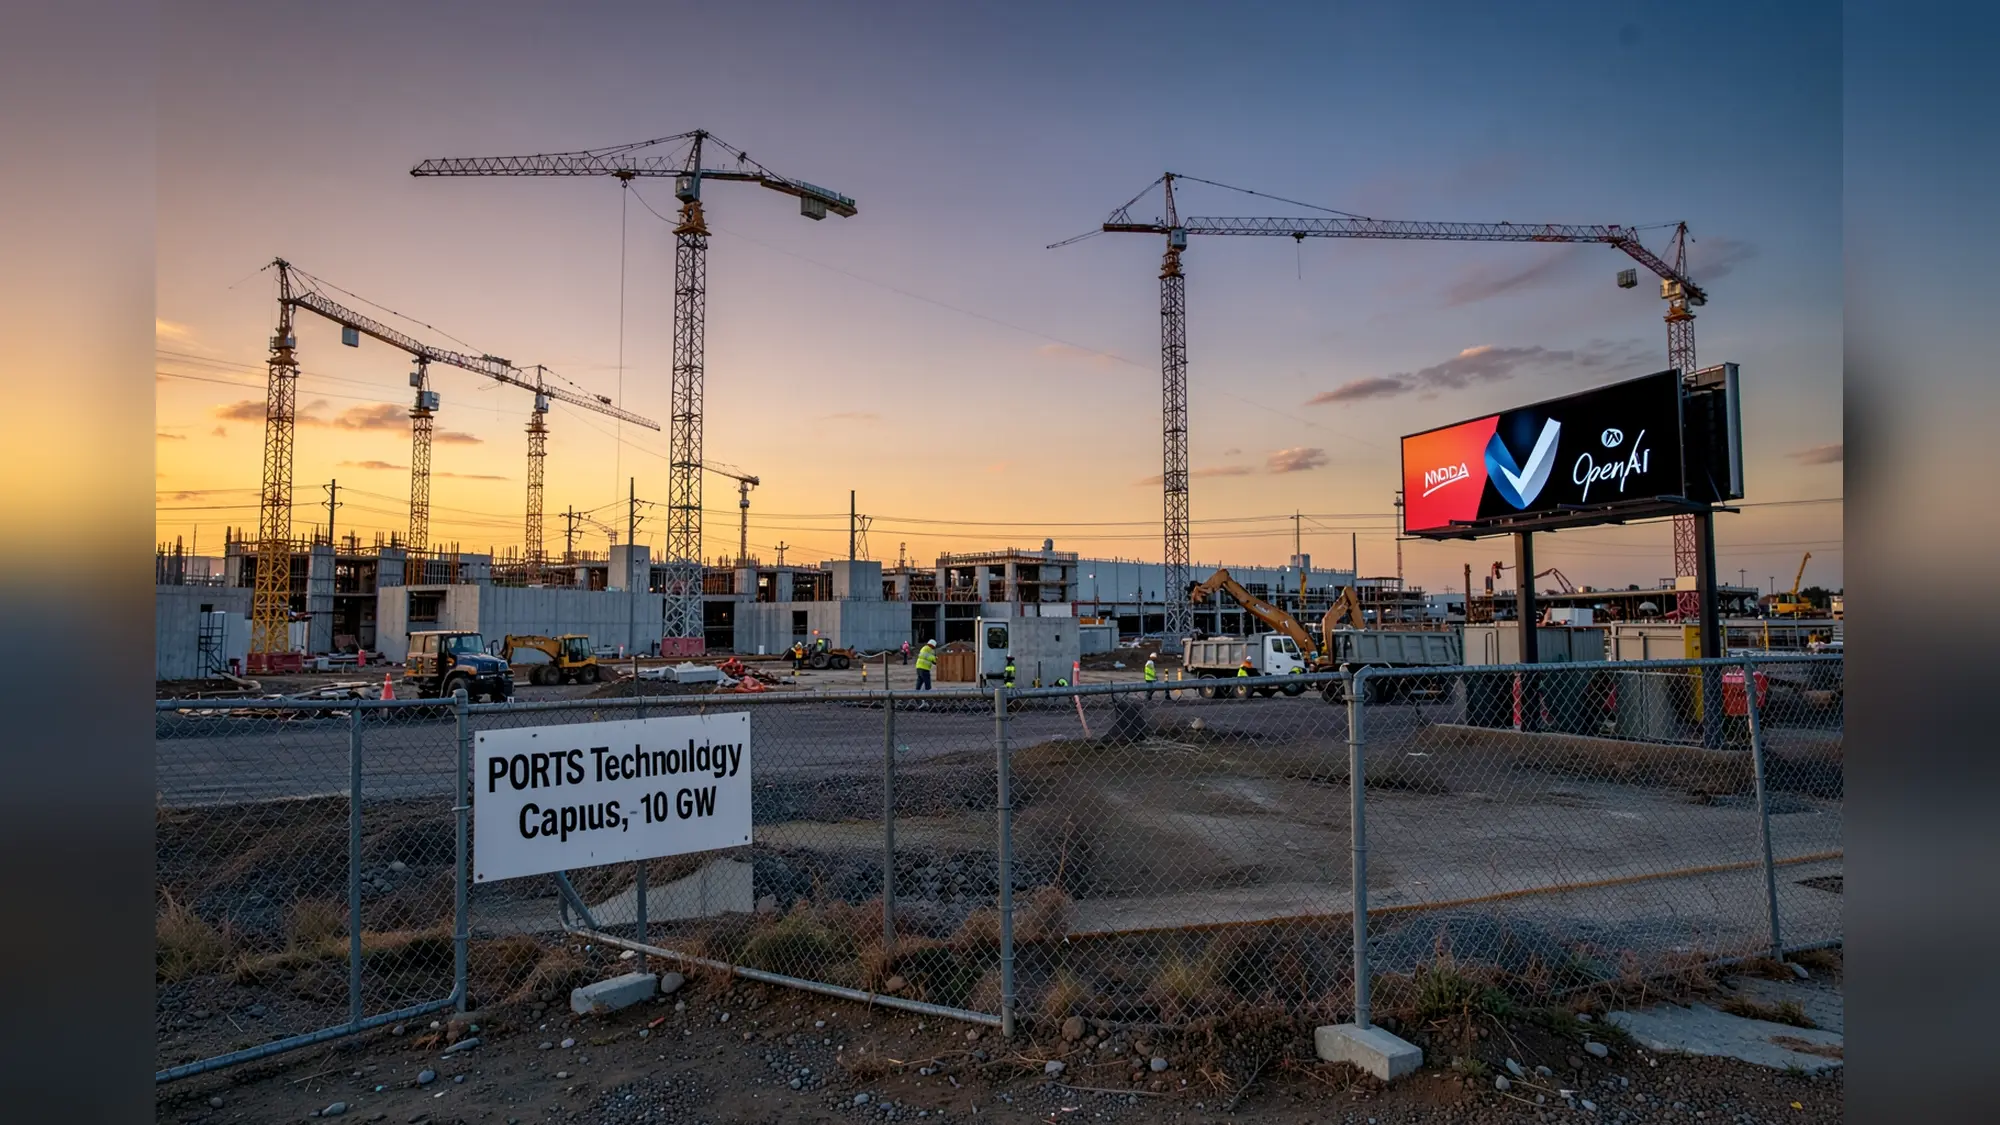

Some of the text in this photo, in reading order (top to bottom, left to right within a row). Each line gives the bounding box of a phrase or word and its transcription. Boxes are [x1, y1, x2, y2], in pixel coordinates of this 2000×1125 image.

[488, 748, 585, 793] PORTS
[640, 791, 669, 824] 10
[676, 785, 717, 820] GW
